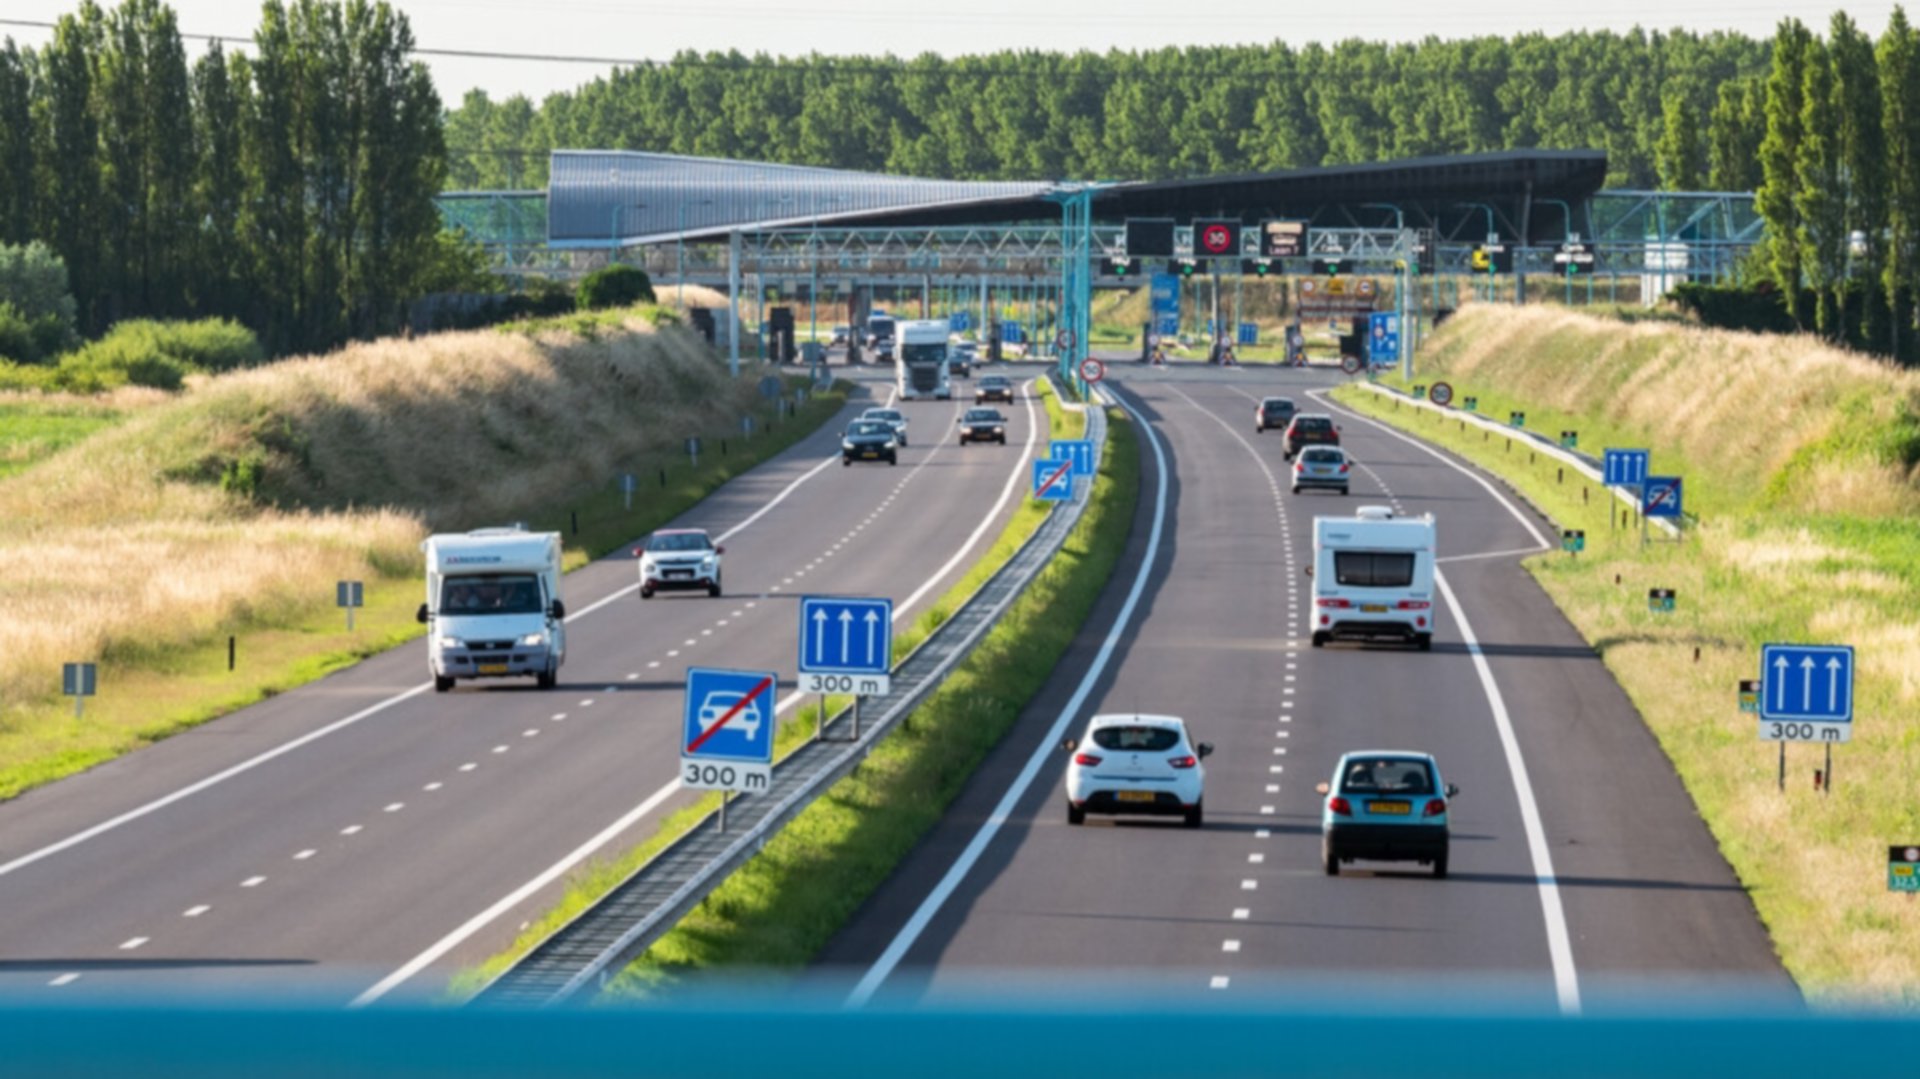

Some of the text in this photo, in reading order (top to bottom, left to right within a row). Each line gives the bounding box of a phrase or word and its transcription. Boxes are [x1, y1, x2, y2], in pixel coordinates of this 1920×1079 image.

[1208, 233, 1226, 244] 30
[810, 675, 878, 693] 300 m
[1771, 722, 1840, 741] 300 m
[685, 764, 766, 788] 300 m
